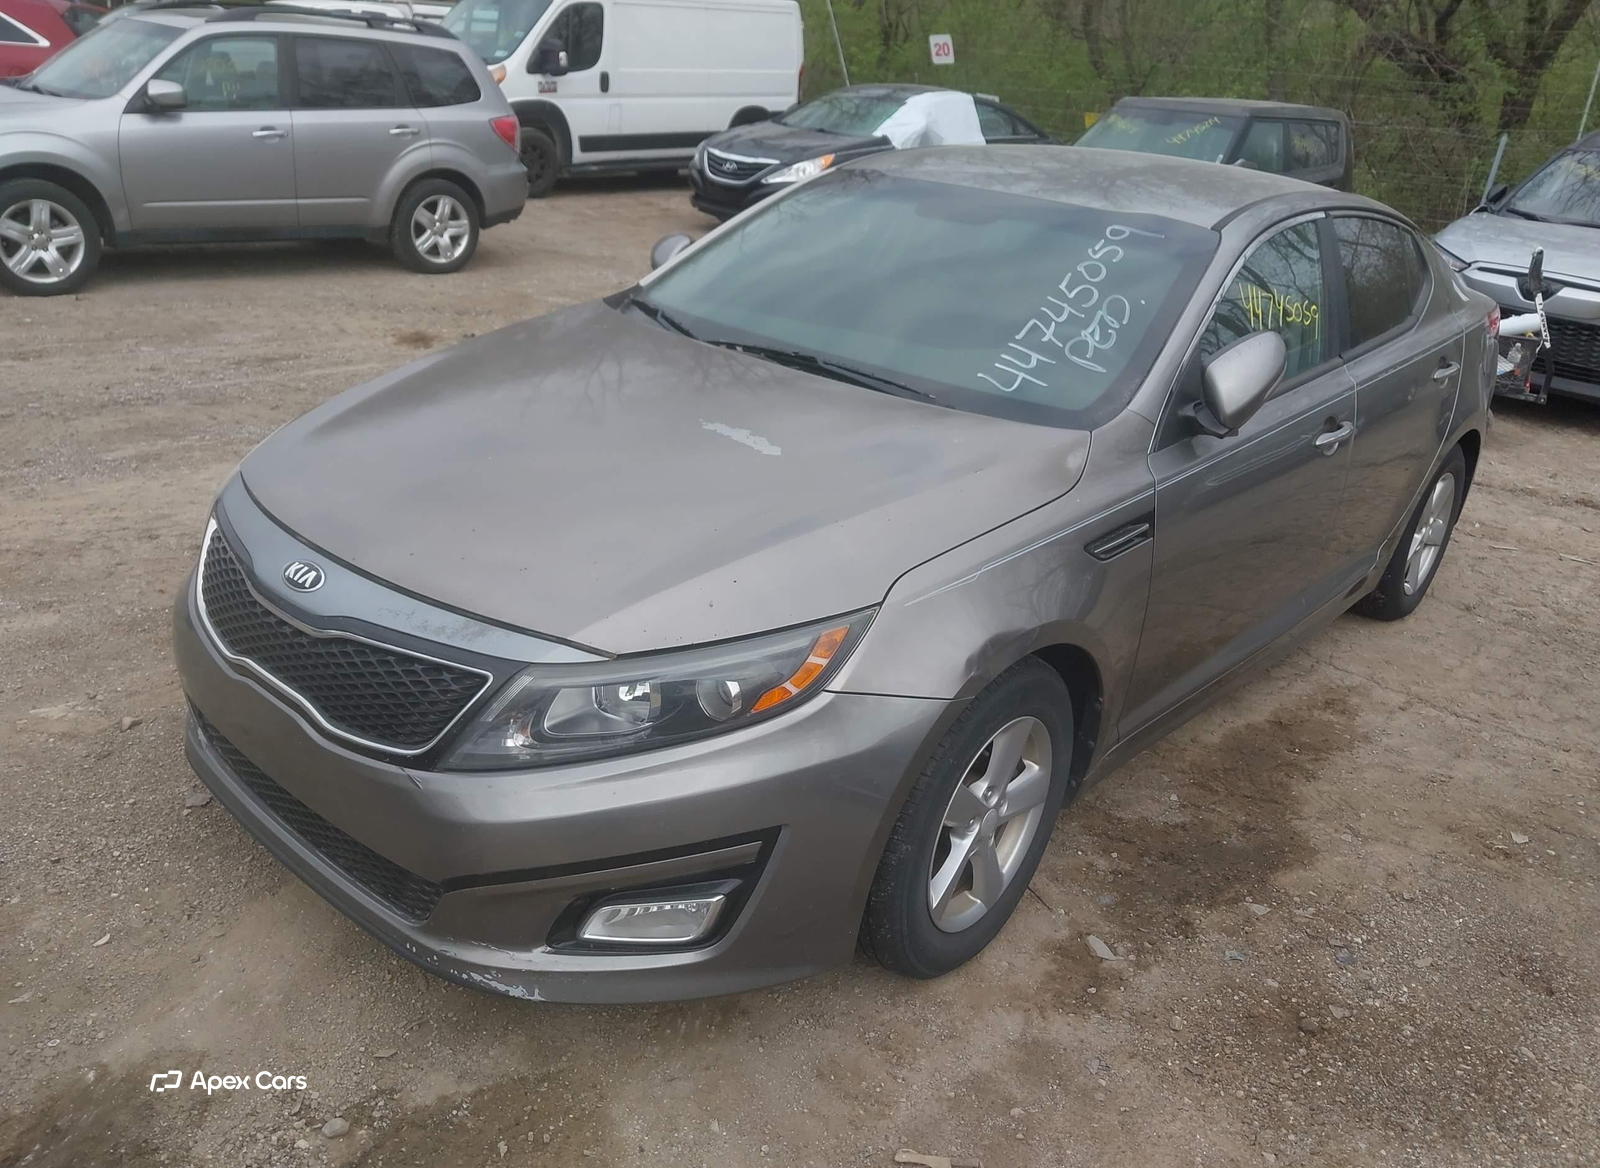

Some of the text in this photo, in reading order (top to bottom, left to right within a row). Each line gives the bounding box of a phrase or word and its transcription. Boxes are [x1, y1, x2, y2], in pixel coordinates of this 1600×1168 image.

[933, 42, 951, 57] 20
[977, 224, 1165, 392] 44745059
[1238, 282, 1319, 340] 44745059
[284, 561, 318, 589] KIA
